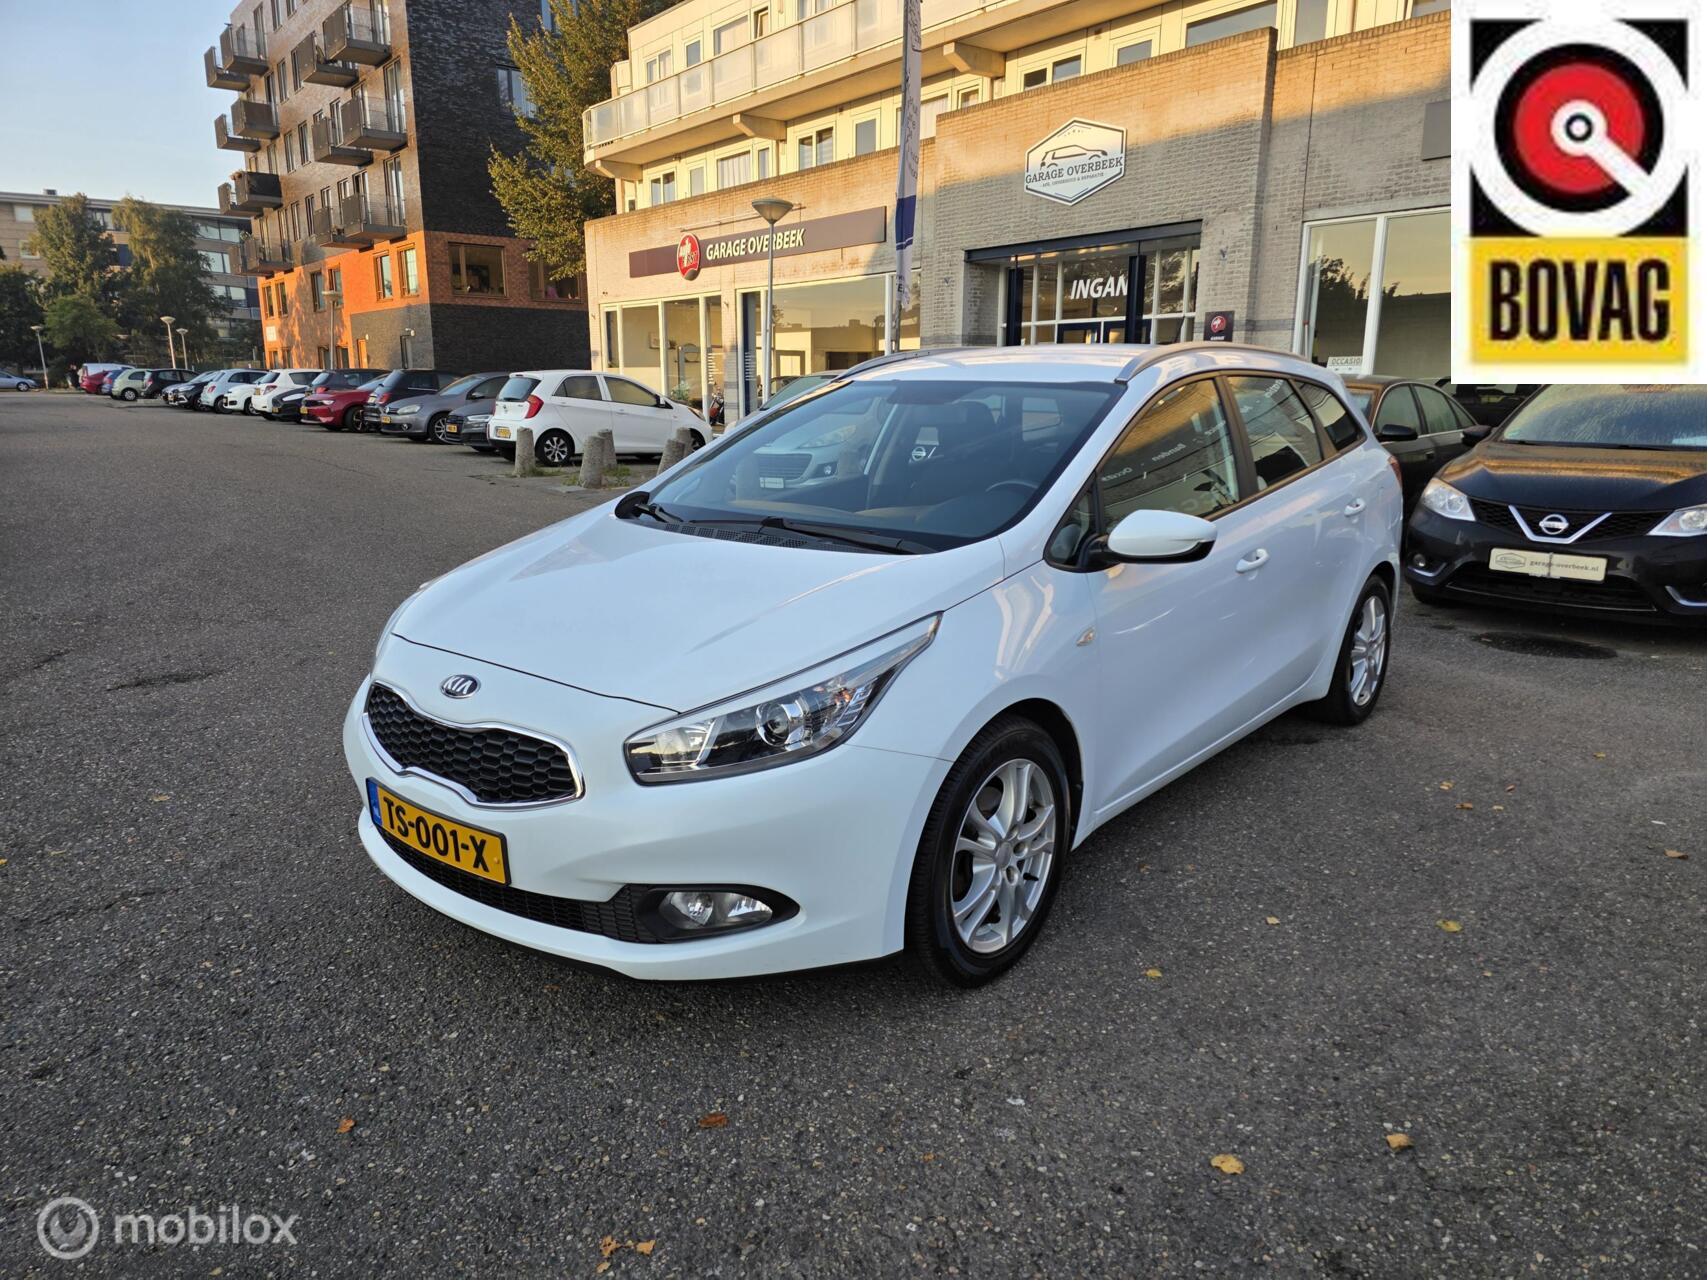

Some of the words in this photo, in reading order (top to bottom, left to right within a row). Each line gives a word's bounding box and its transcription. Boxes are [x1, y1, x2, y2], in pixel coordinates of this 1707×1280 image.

[1025, 168, 1064, 184] GARAGE
[1066, 156, 1123, 176] OVERBEEK
[706, 239, 746, 261] GARAGE
[1070, 274, 1129, 300] INGAN
[1331, 357, 1362, 365] OCCASIO
[443, 676, 473, 695] KIA
[383, 796, 490, 873] TS-001-X
